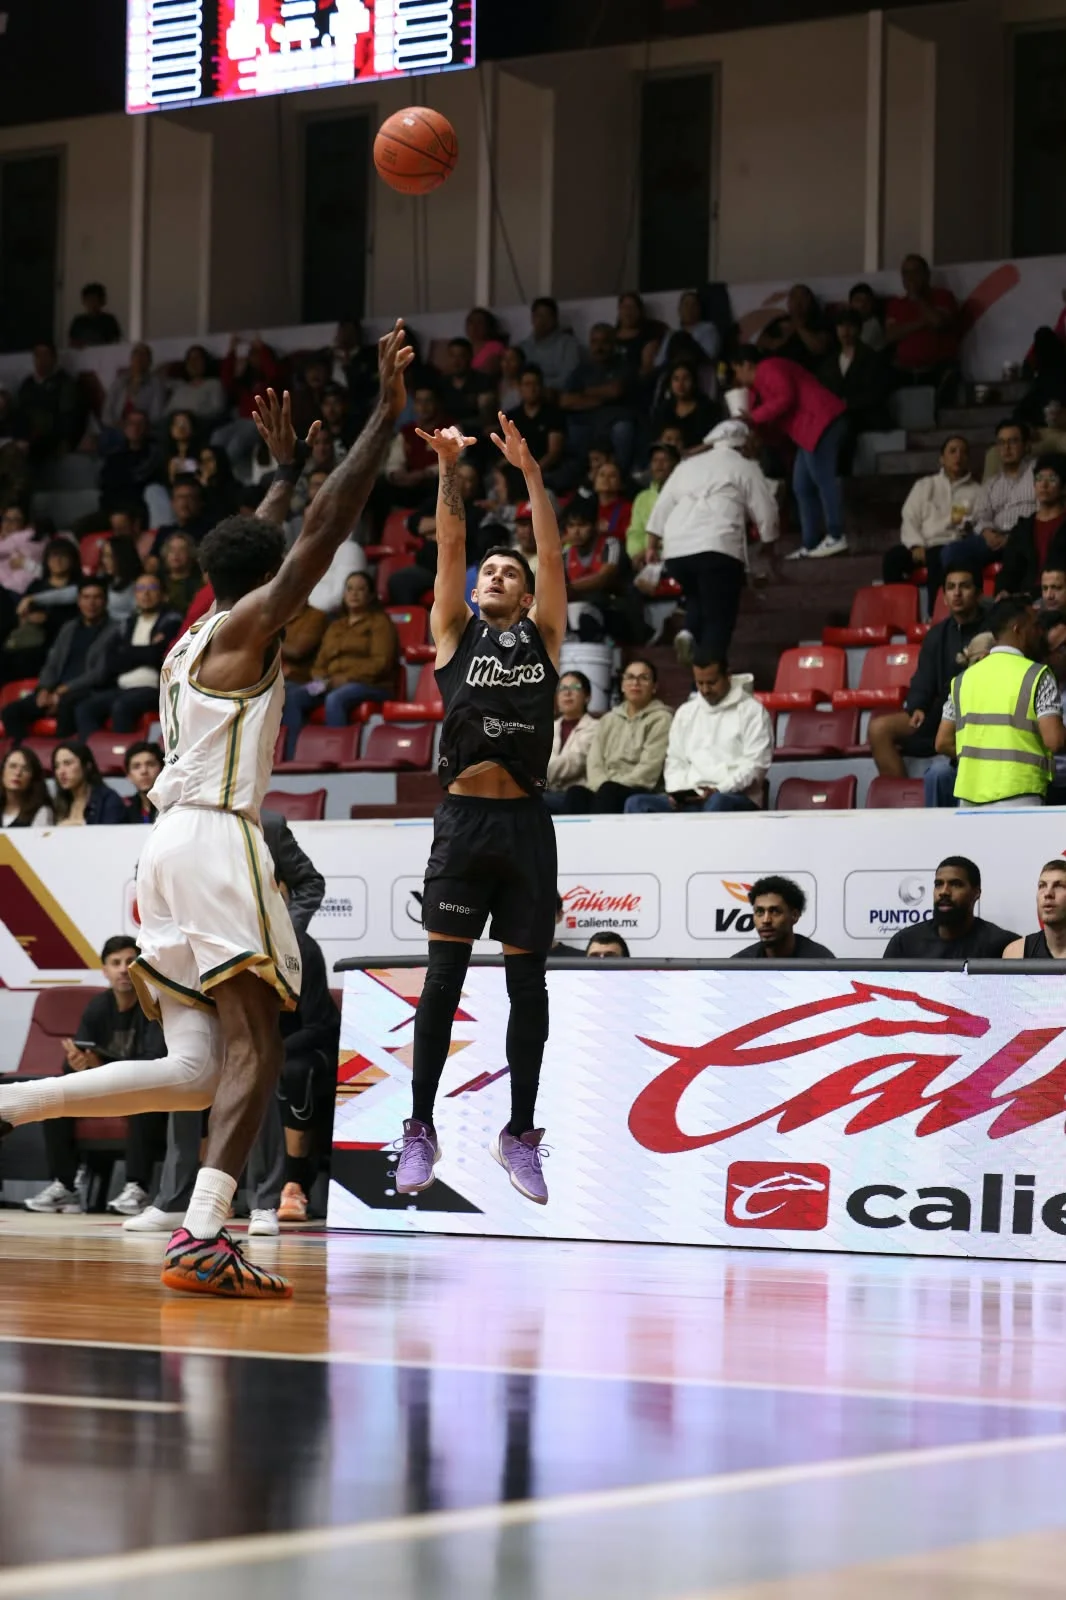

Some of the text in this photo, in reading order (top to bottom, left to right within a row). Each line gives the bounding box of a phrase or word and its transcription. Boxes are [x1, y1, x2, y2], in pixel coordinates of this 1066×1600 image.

[562, 885, 641, 913] Caliente
[439, 901, 470, 915] sense
[577, 917, 638, 928] caliente.mx
[715, 908, 756, 933] Vo
[869, 909, 920, 924] PUNTO
